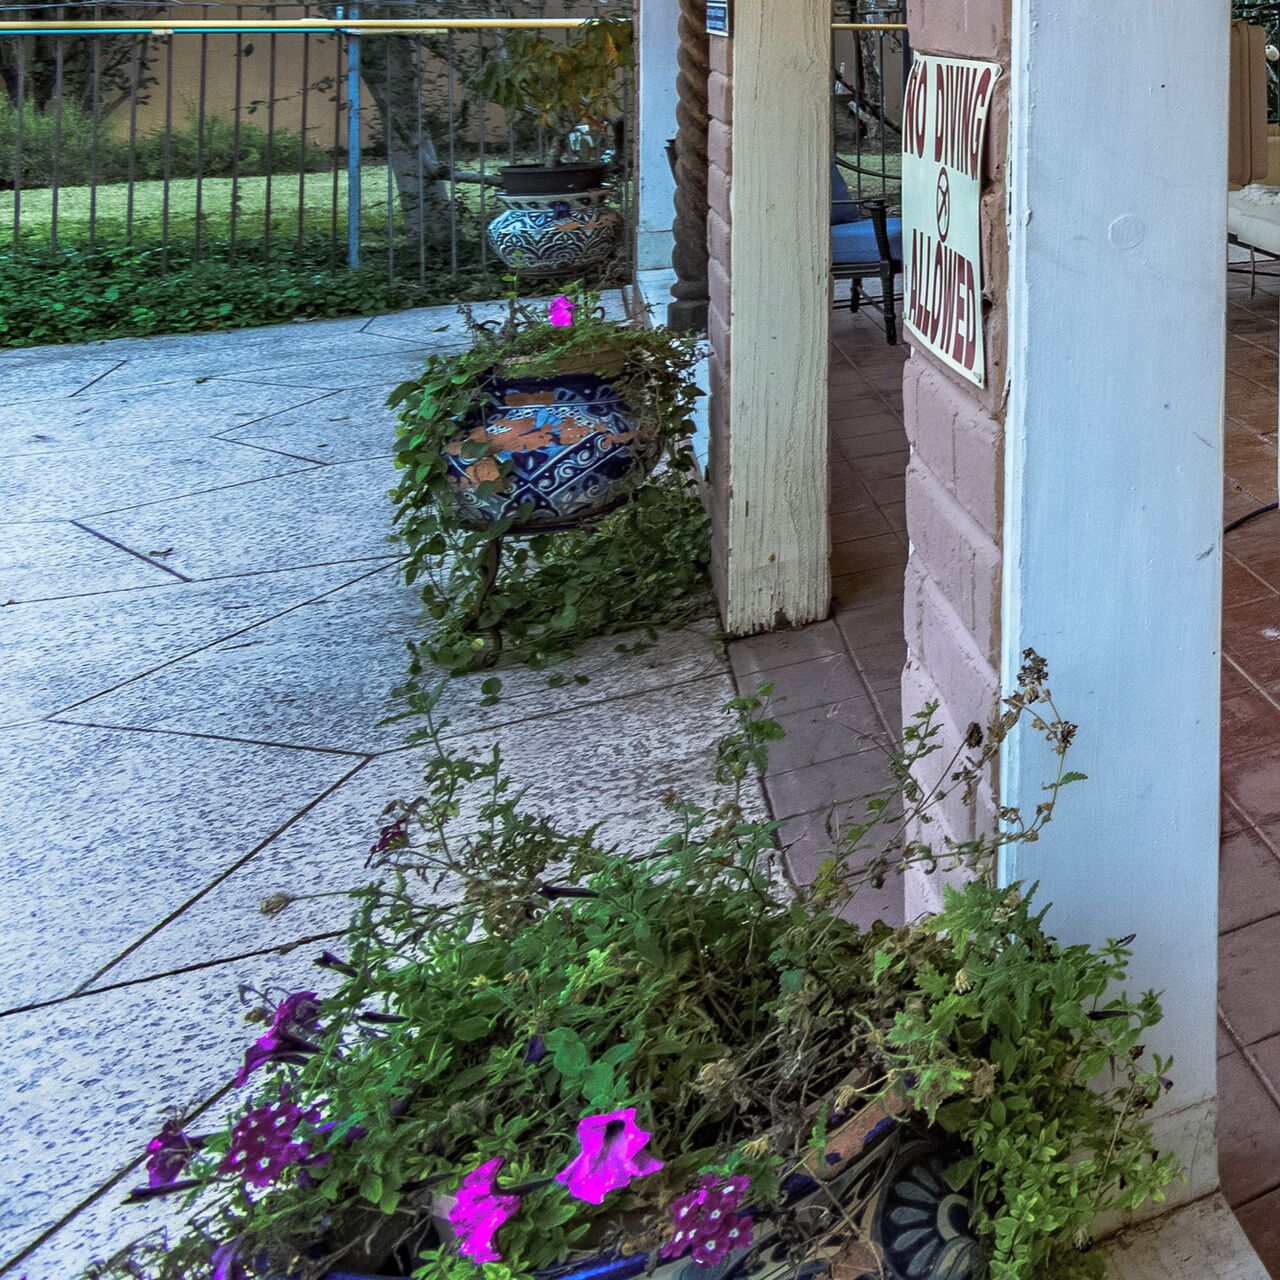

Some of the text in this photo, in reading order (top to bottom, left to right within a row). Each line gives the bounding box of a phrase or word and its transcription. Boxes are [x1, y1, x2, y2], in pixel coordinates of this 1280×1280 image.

[904, 59, 992, 181] NO DIVING
[908, 228, 977, 371] ALLOWED
